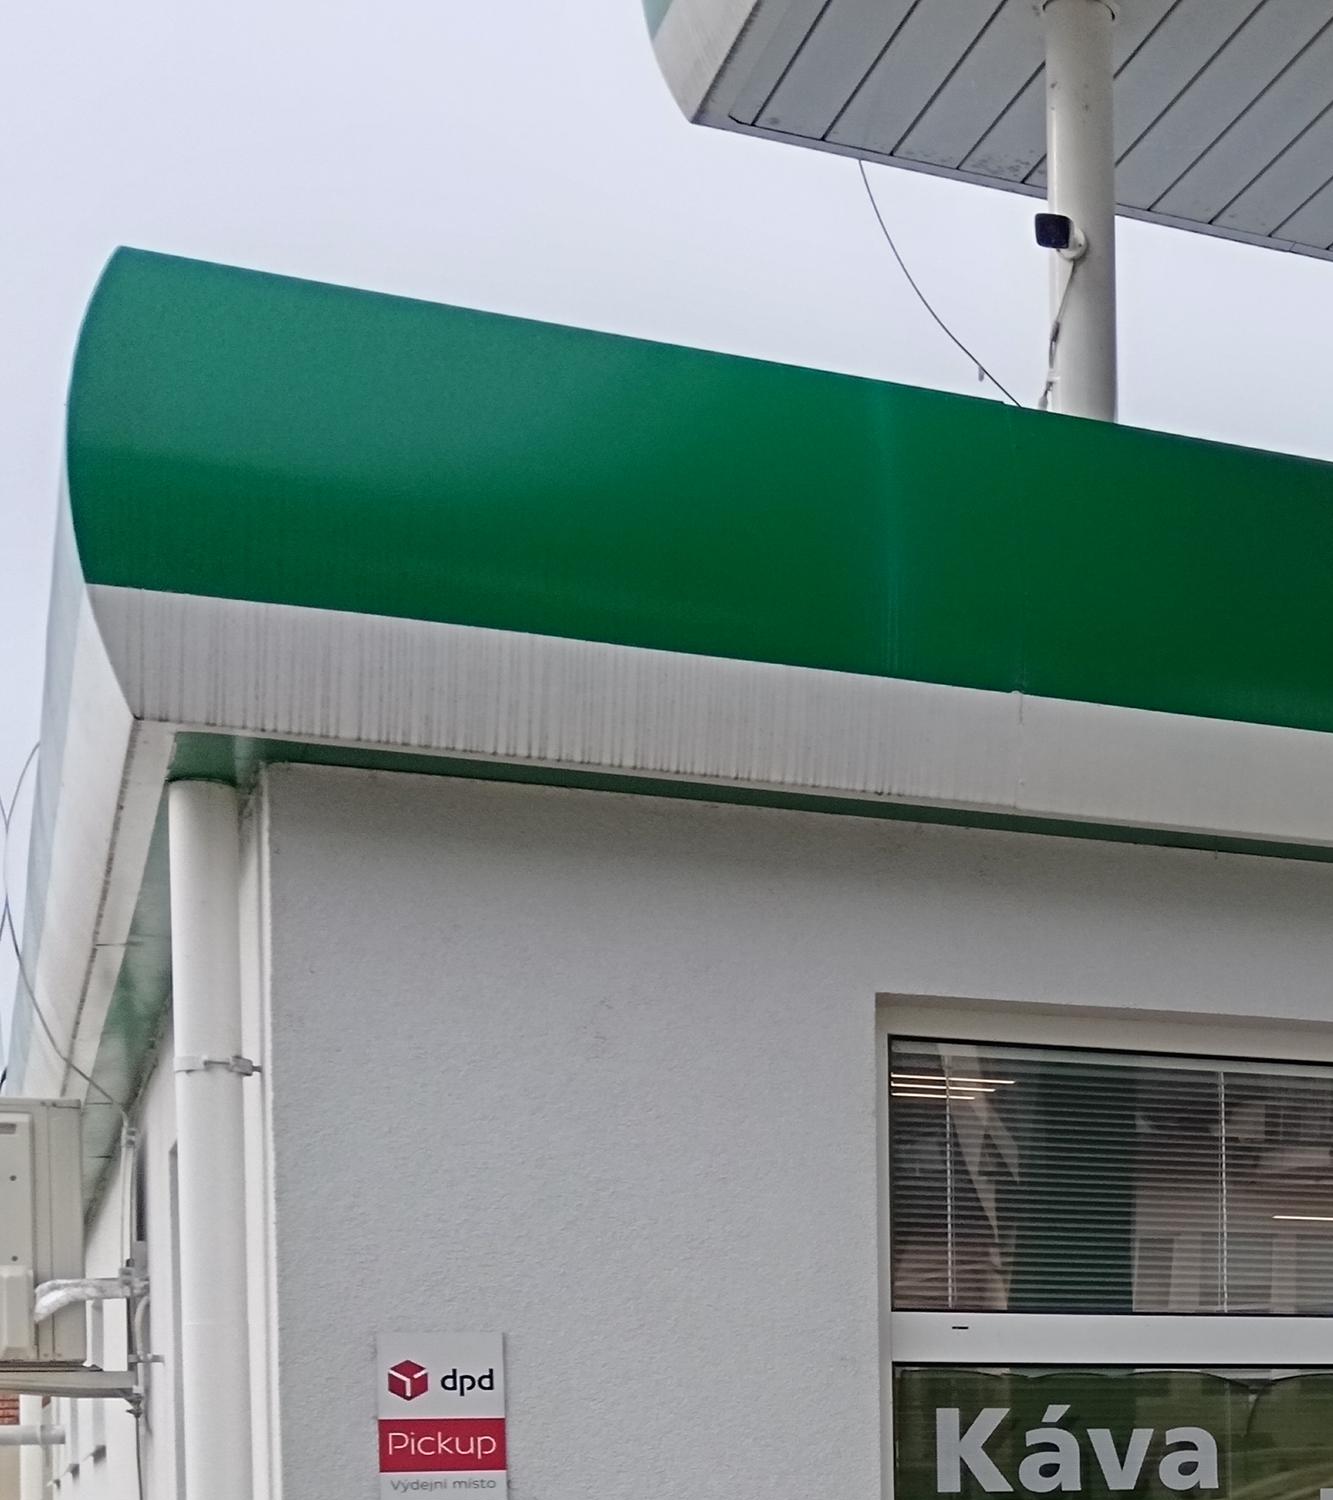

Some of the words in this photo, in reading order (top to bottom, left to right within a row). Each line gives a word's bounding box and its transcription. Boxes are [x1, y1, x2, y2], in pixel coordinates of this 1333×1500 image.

[440, 1368, 495, 1397] dpd
[388, 1432, 497, 1459] Pickup
[935, 1403, 1220, 1495] Káva
